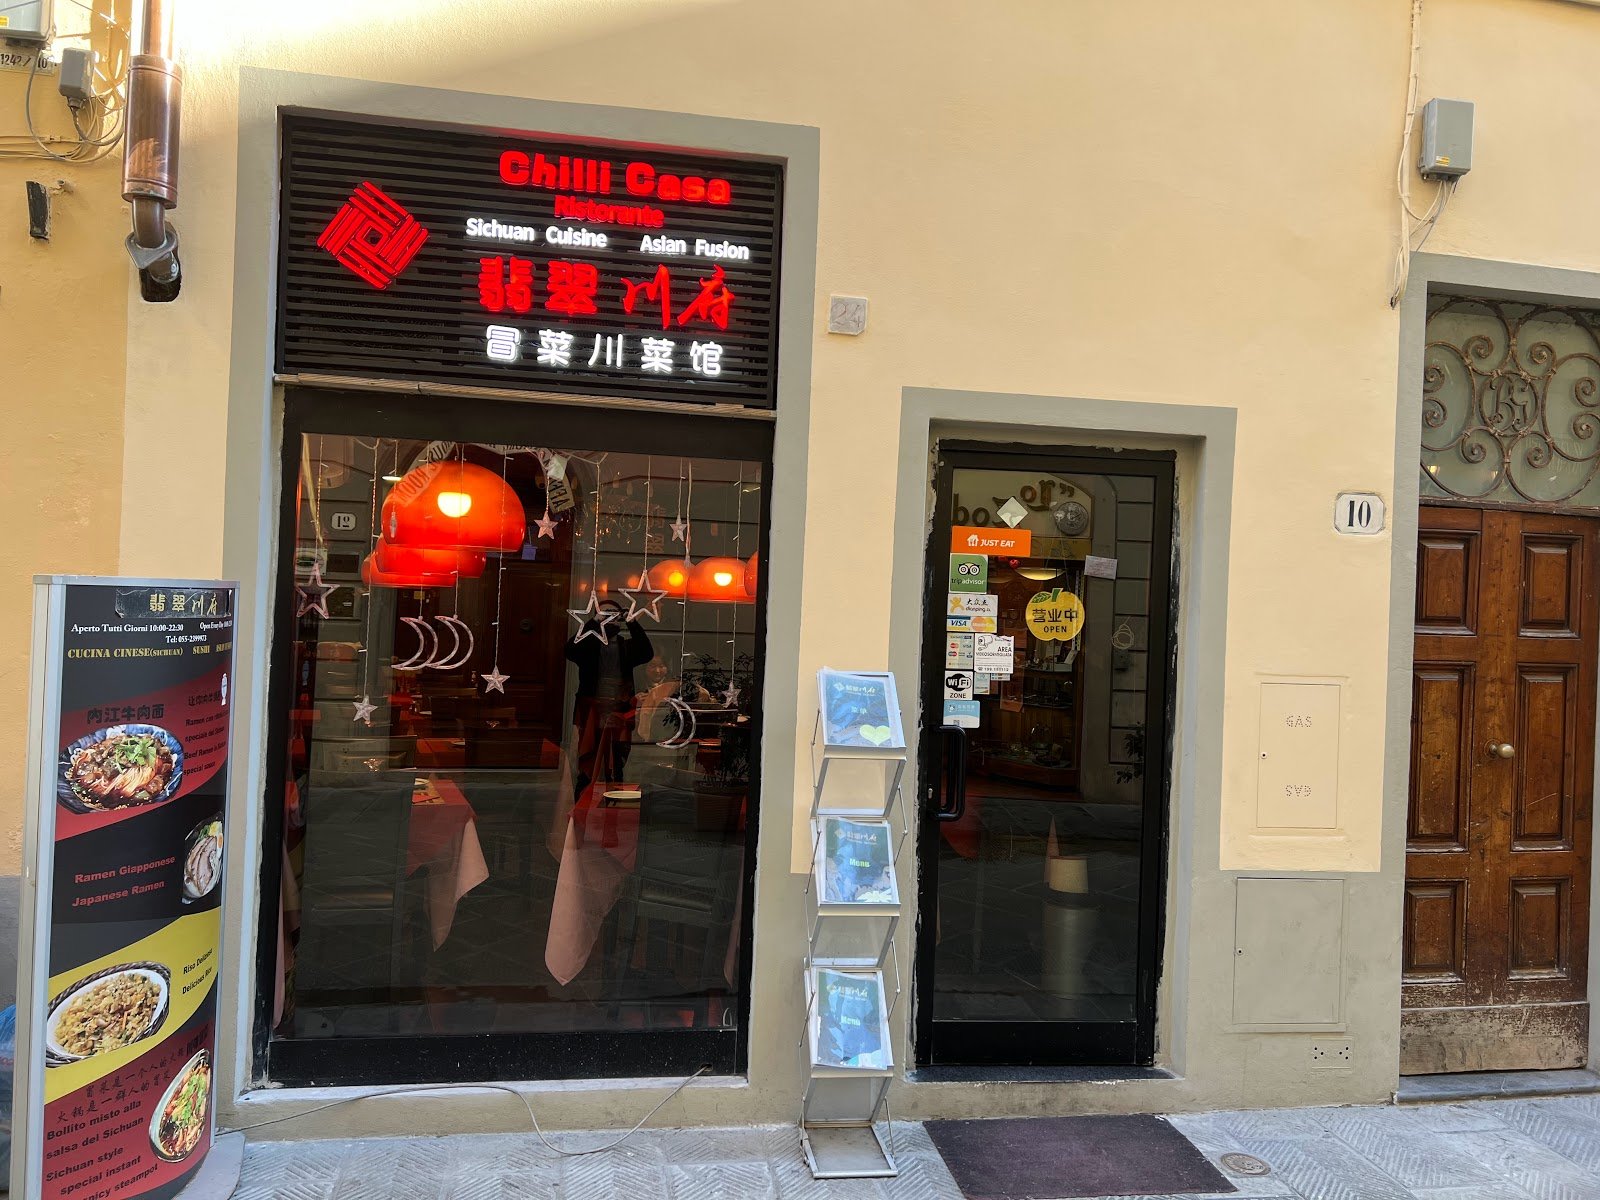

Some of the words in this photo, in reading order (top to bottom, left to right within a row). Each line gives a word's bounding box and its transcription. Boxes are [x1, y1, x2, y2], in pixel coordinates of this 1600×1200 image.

[499, 150, 612, 194] Chilli
[625, 162, 732, 205] Casa
[554, 195, 666, 228] Ristorante
[465, 217, 536, 242] Sichuan
[545, 226, 608, 248] Cuisine
[640, 234, 687, 256] Asian
[695, 239, 751, 260] Fusion
[478, 256, 735, 331] 翡翠川府
[485, 324, 724, 376] 冒菜川菜馆
[1347, 500, 1372, 528] 10
[980, 539, 999, 547] JUST
[1000, 540, 1016, 548] EAT
[71, 623, 101, 635] Aperto
[101, 623, 122, 632] Tutti
[123, 624, 148, 632] Giorni
[149, 624, 184, 632] 10:00-22:30
[1032, 608, 1078, 623] 营业中
[67, 648, 111, 659] CUCINA
[87, 704, 165, 724] 内江牛肉面
[1286, 715, 1312, 728] GAS
[183, 750, 198, 759] Beef
[183, 764, 203, 776] special
[75, 870, 116, 884] Ramen
[119, 856, 176, 875] Giapponese
[72, 889, 129, 907] Japanese
[131, 881, 165, 895] Ramen
[183, 963, 196, 975] Riso
[46, 1122, 86, 1140] Bollito
[89, 1109, 121, 1126] misto
[123, 1101, 141, 1113] alla
[46, 1143, 78, 1160] salsa
[81, 1133, 100, 1147] del
[102, 1117, 144, 1139] Sichuan
[46, 1160, 94, 1182] Sichuan
[97, 1147, 124, 1163] style
[60, 1172, 103, 1196] special
[105, 1155, 141, 1177] instant
[114, 1163, 159, 1191] steampot
